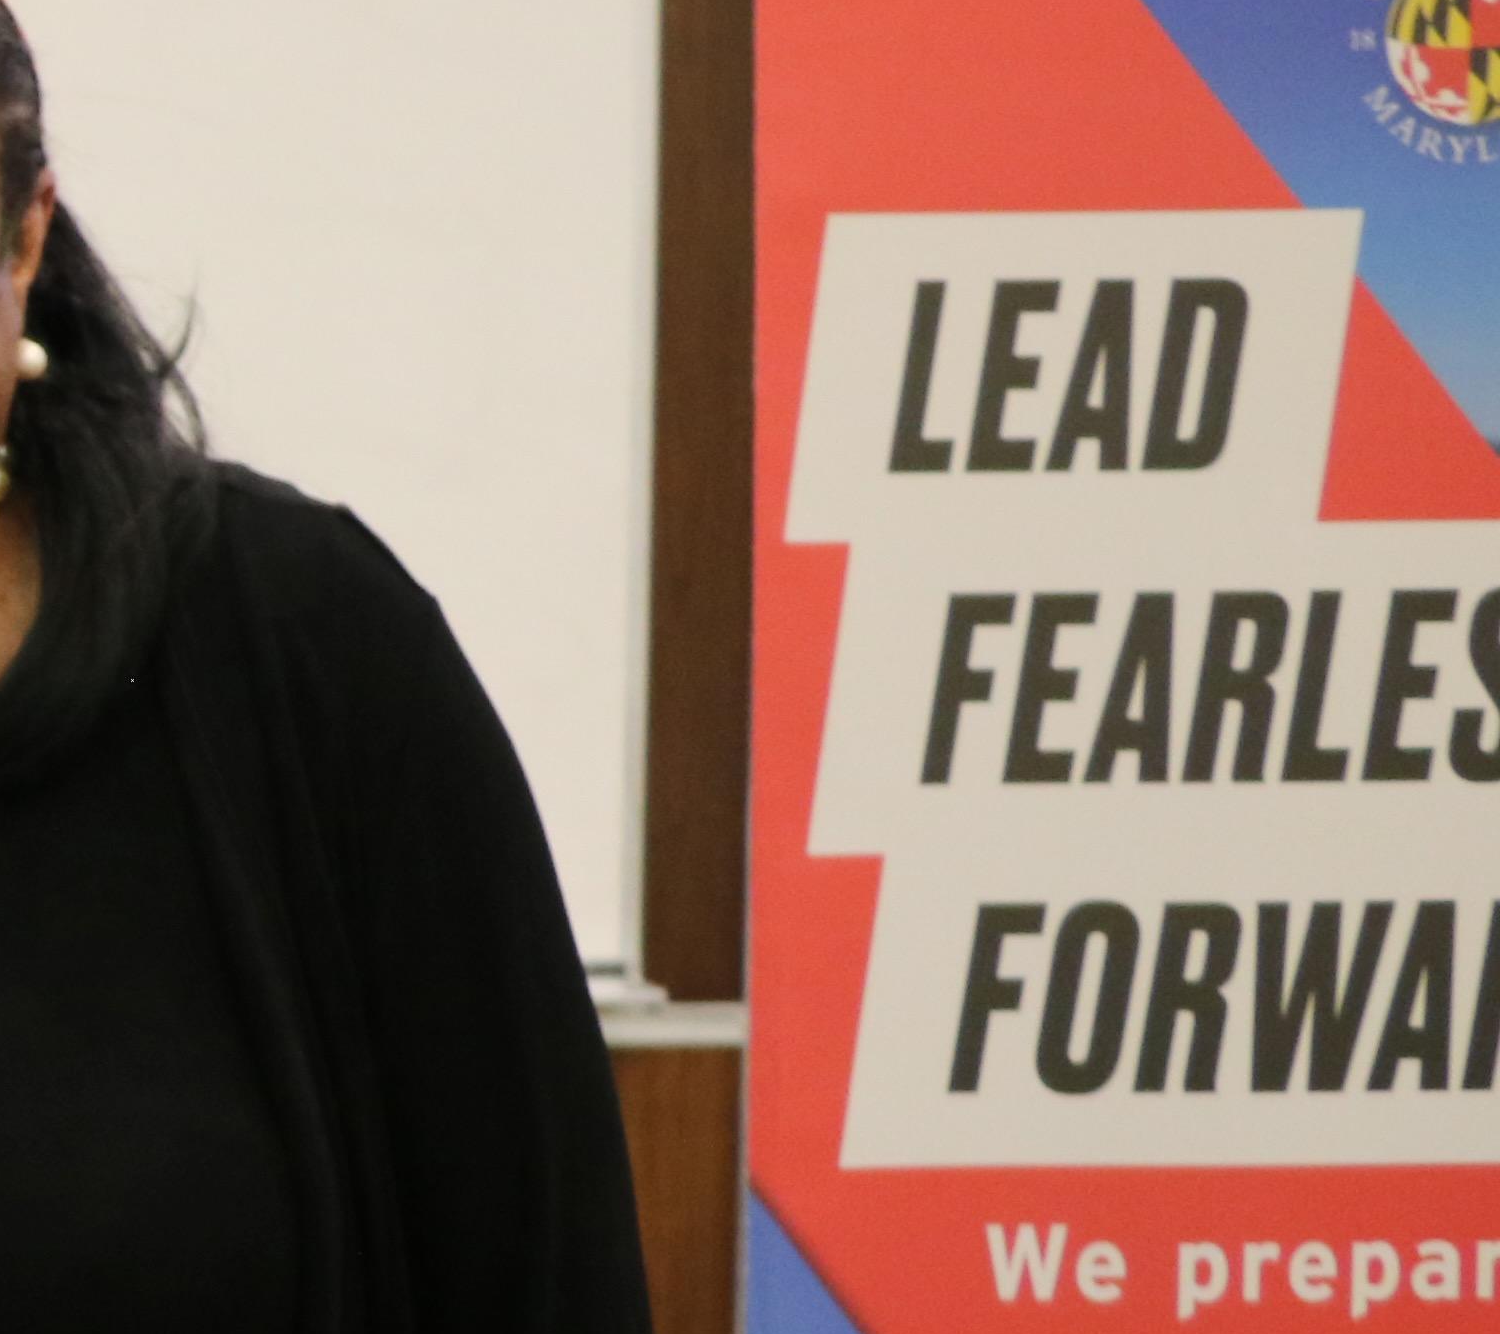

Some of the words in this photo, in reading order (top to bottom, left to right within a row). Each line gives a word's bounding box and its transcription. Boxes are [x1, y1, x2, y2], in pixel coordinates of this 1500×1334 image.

[888, 278, 1250, 473] LEAD
[920, 588, 1500, 785] FEARLES
[985, 1222, 1129, 1304] We
